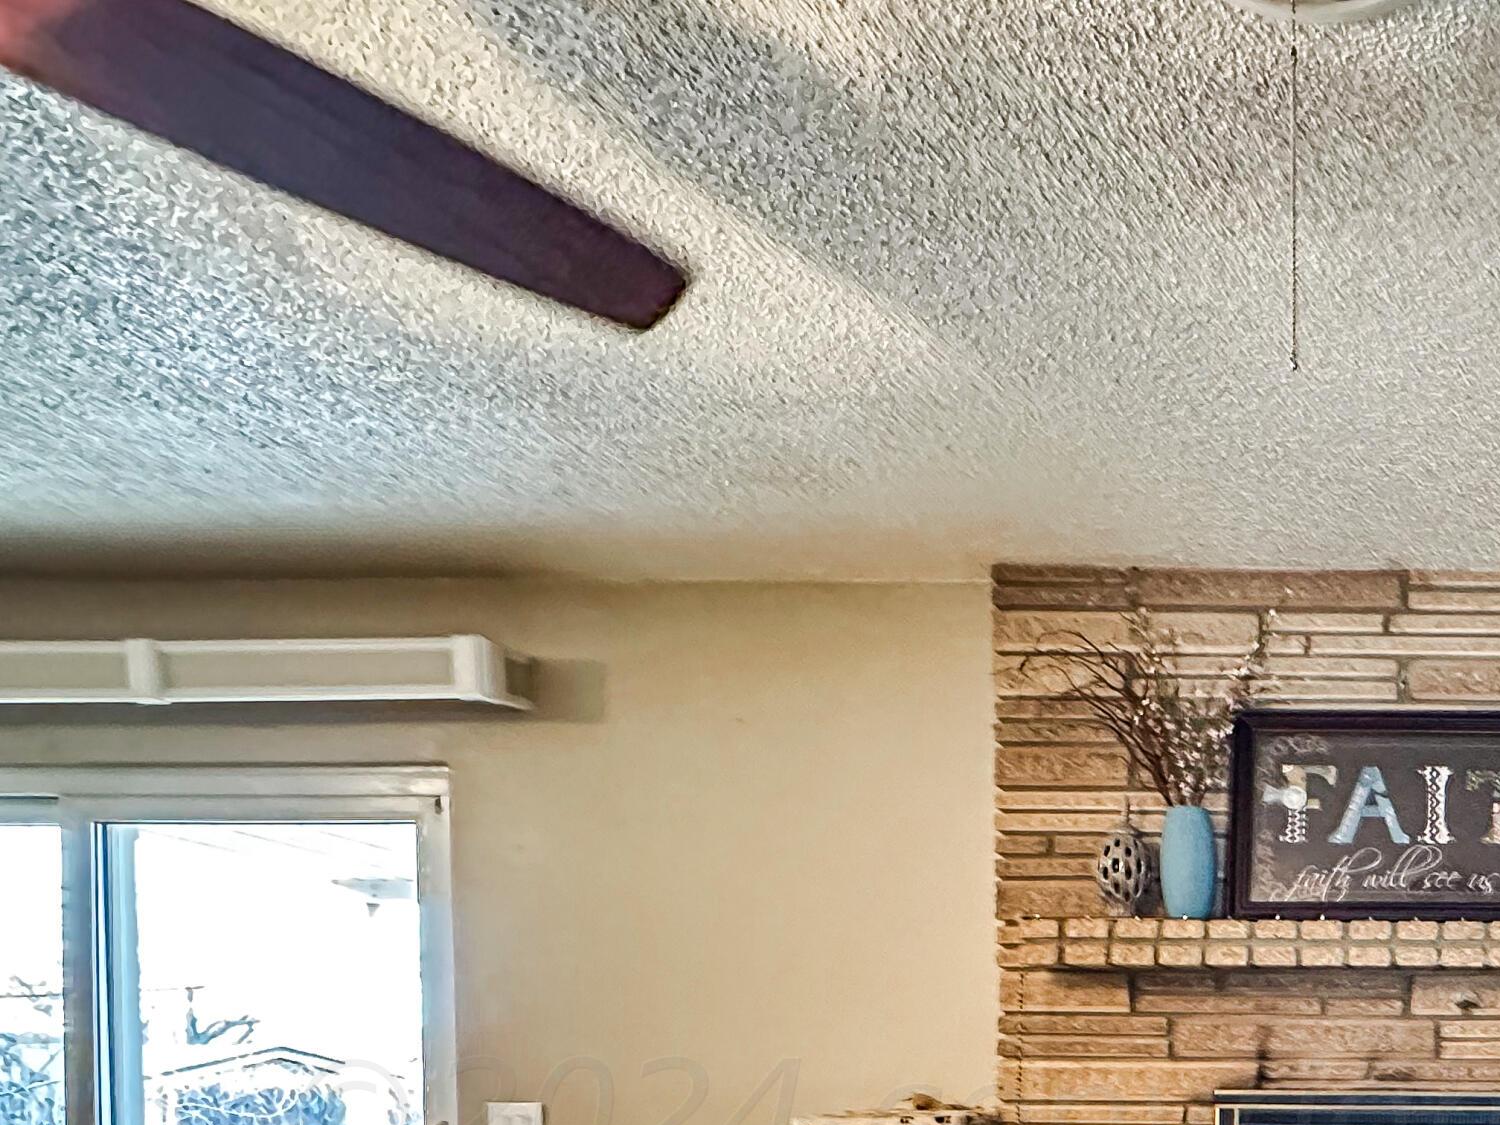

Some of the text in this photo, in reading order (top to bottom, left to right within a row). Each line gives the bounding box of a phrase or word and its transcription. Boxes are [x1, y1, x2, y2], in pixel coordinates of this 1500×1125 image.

[1284, 846, 1382, 902] faith
[1362, 844, 1443, 890] will
[1422, 870, 1463, 889] see
[1467, 872, 1500, 895] us
